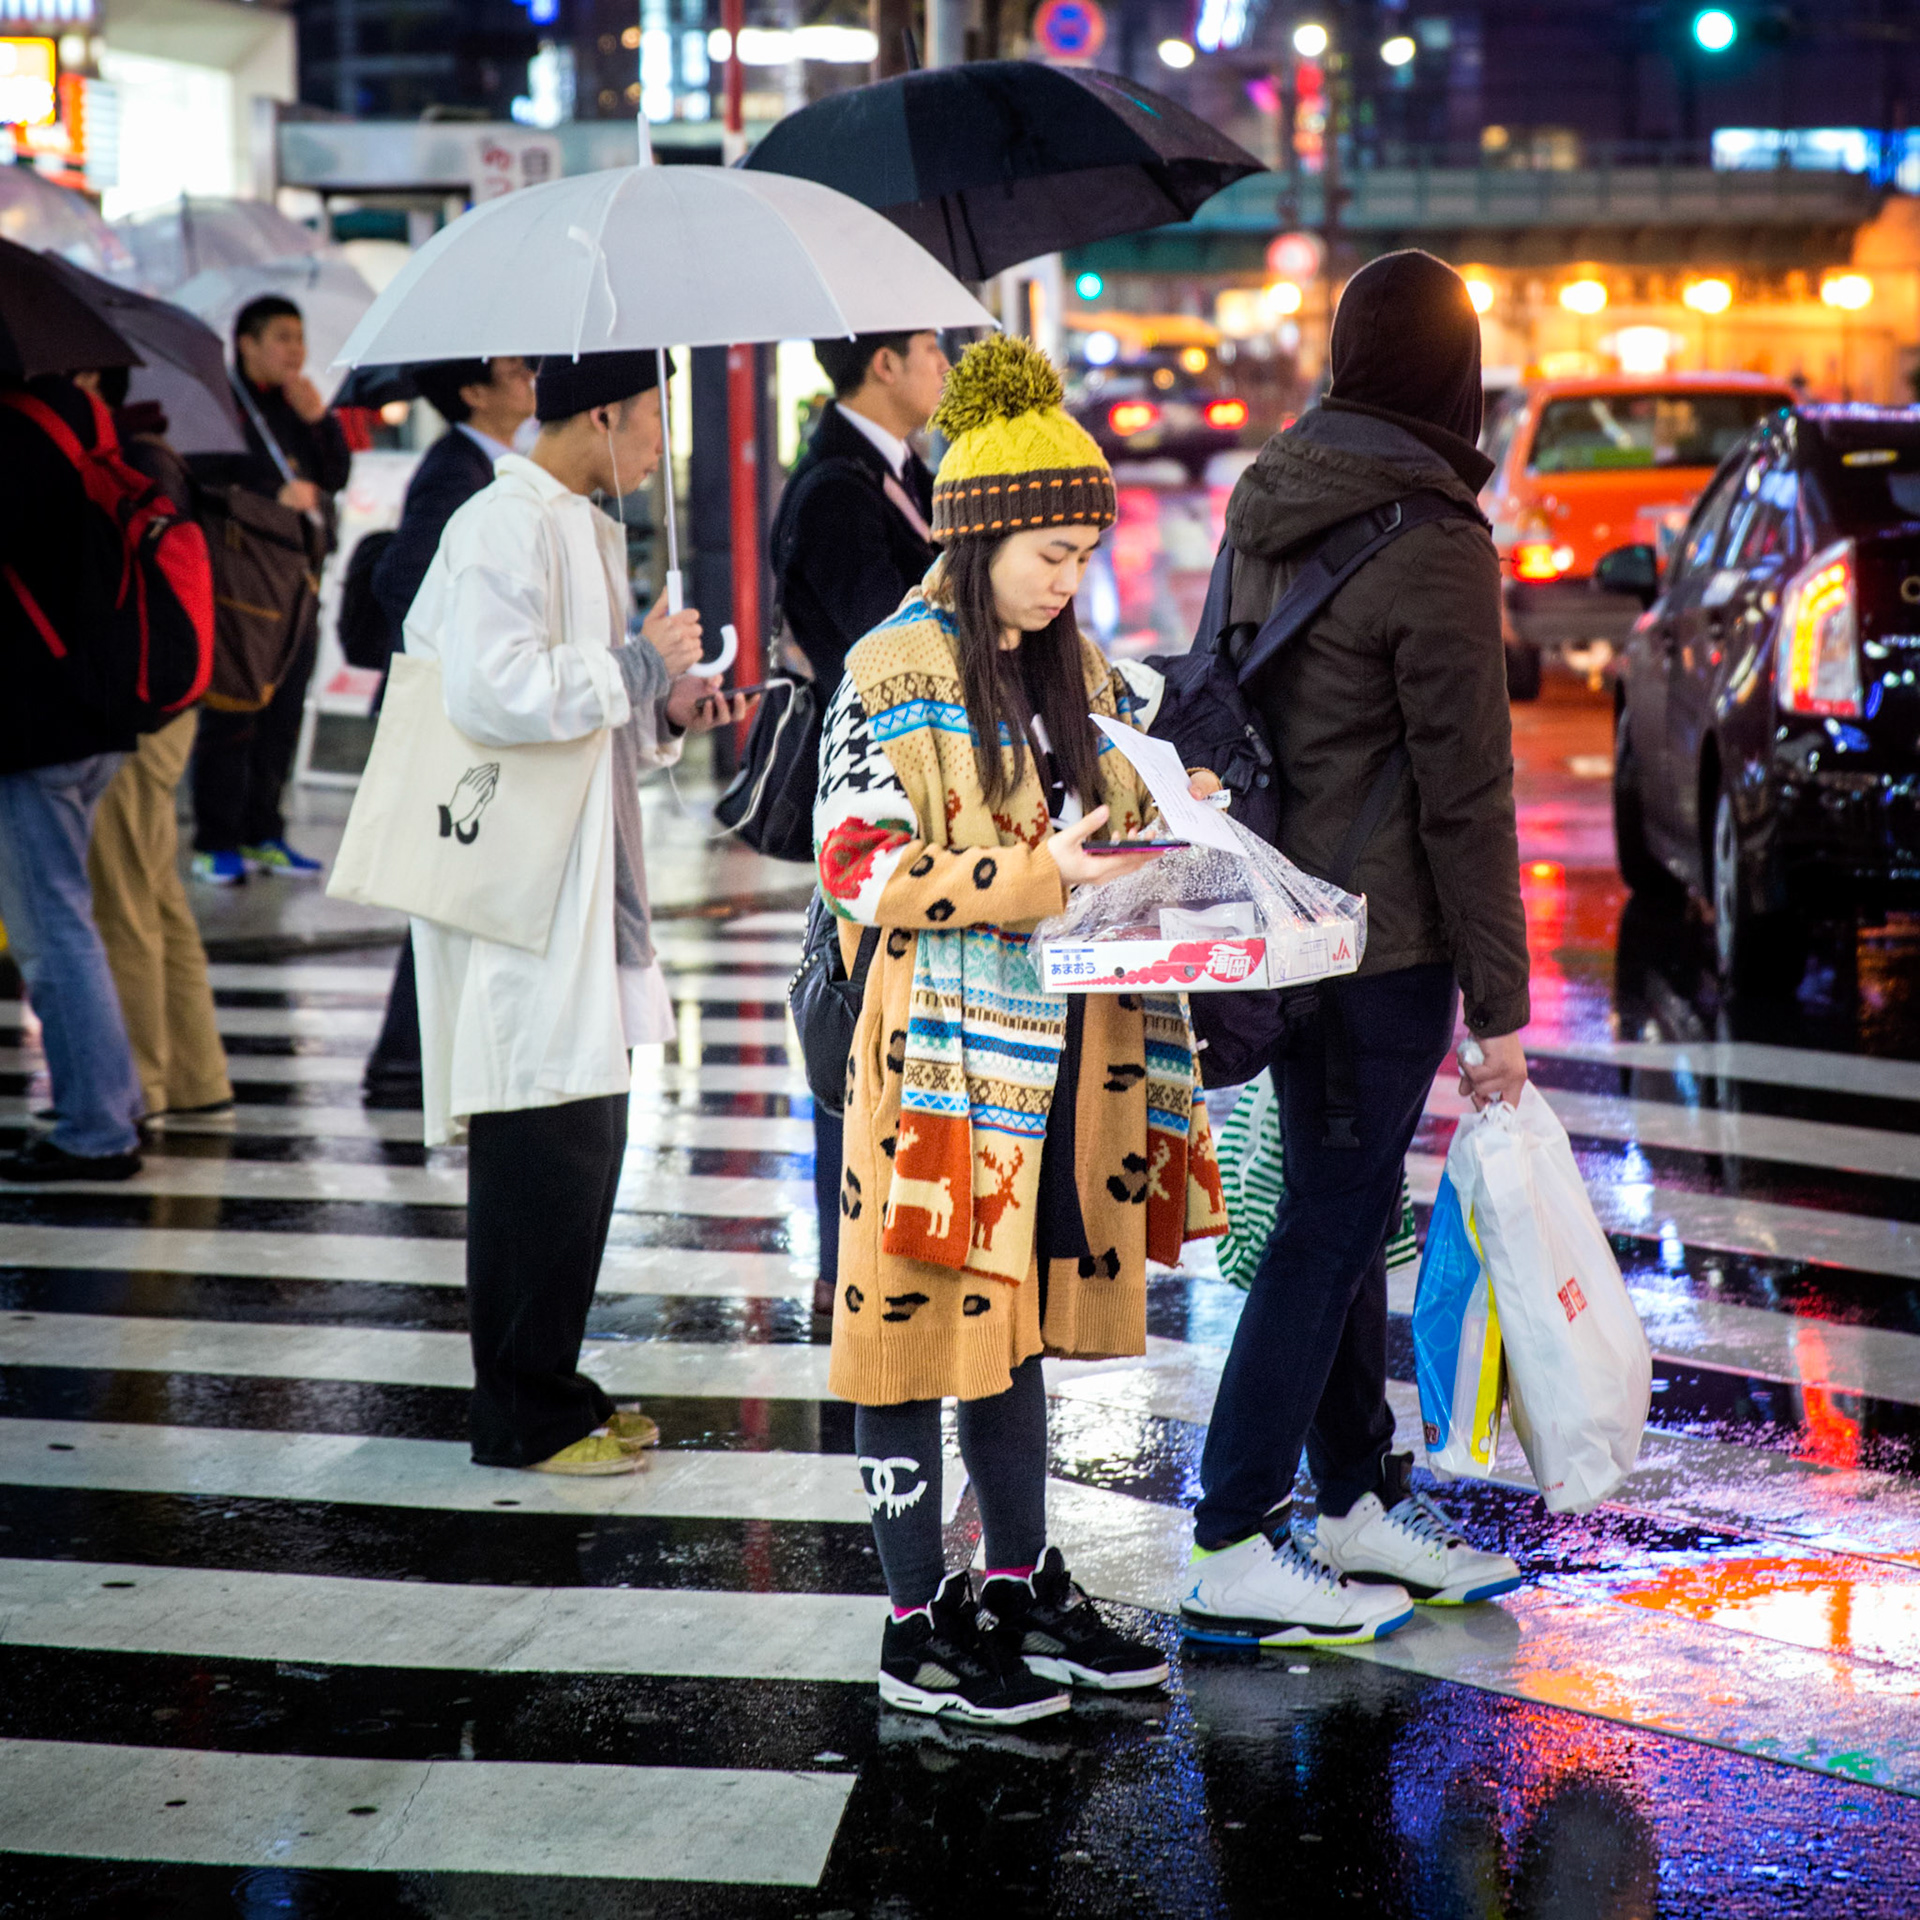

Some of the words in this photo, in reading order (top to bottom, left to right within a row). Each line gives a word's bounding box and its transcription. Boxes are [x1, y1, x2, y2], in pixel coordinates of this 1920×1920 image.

[1051, 962, 1096, 975] あまおう
[1205, 943, 1251, 978] 福岡
